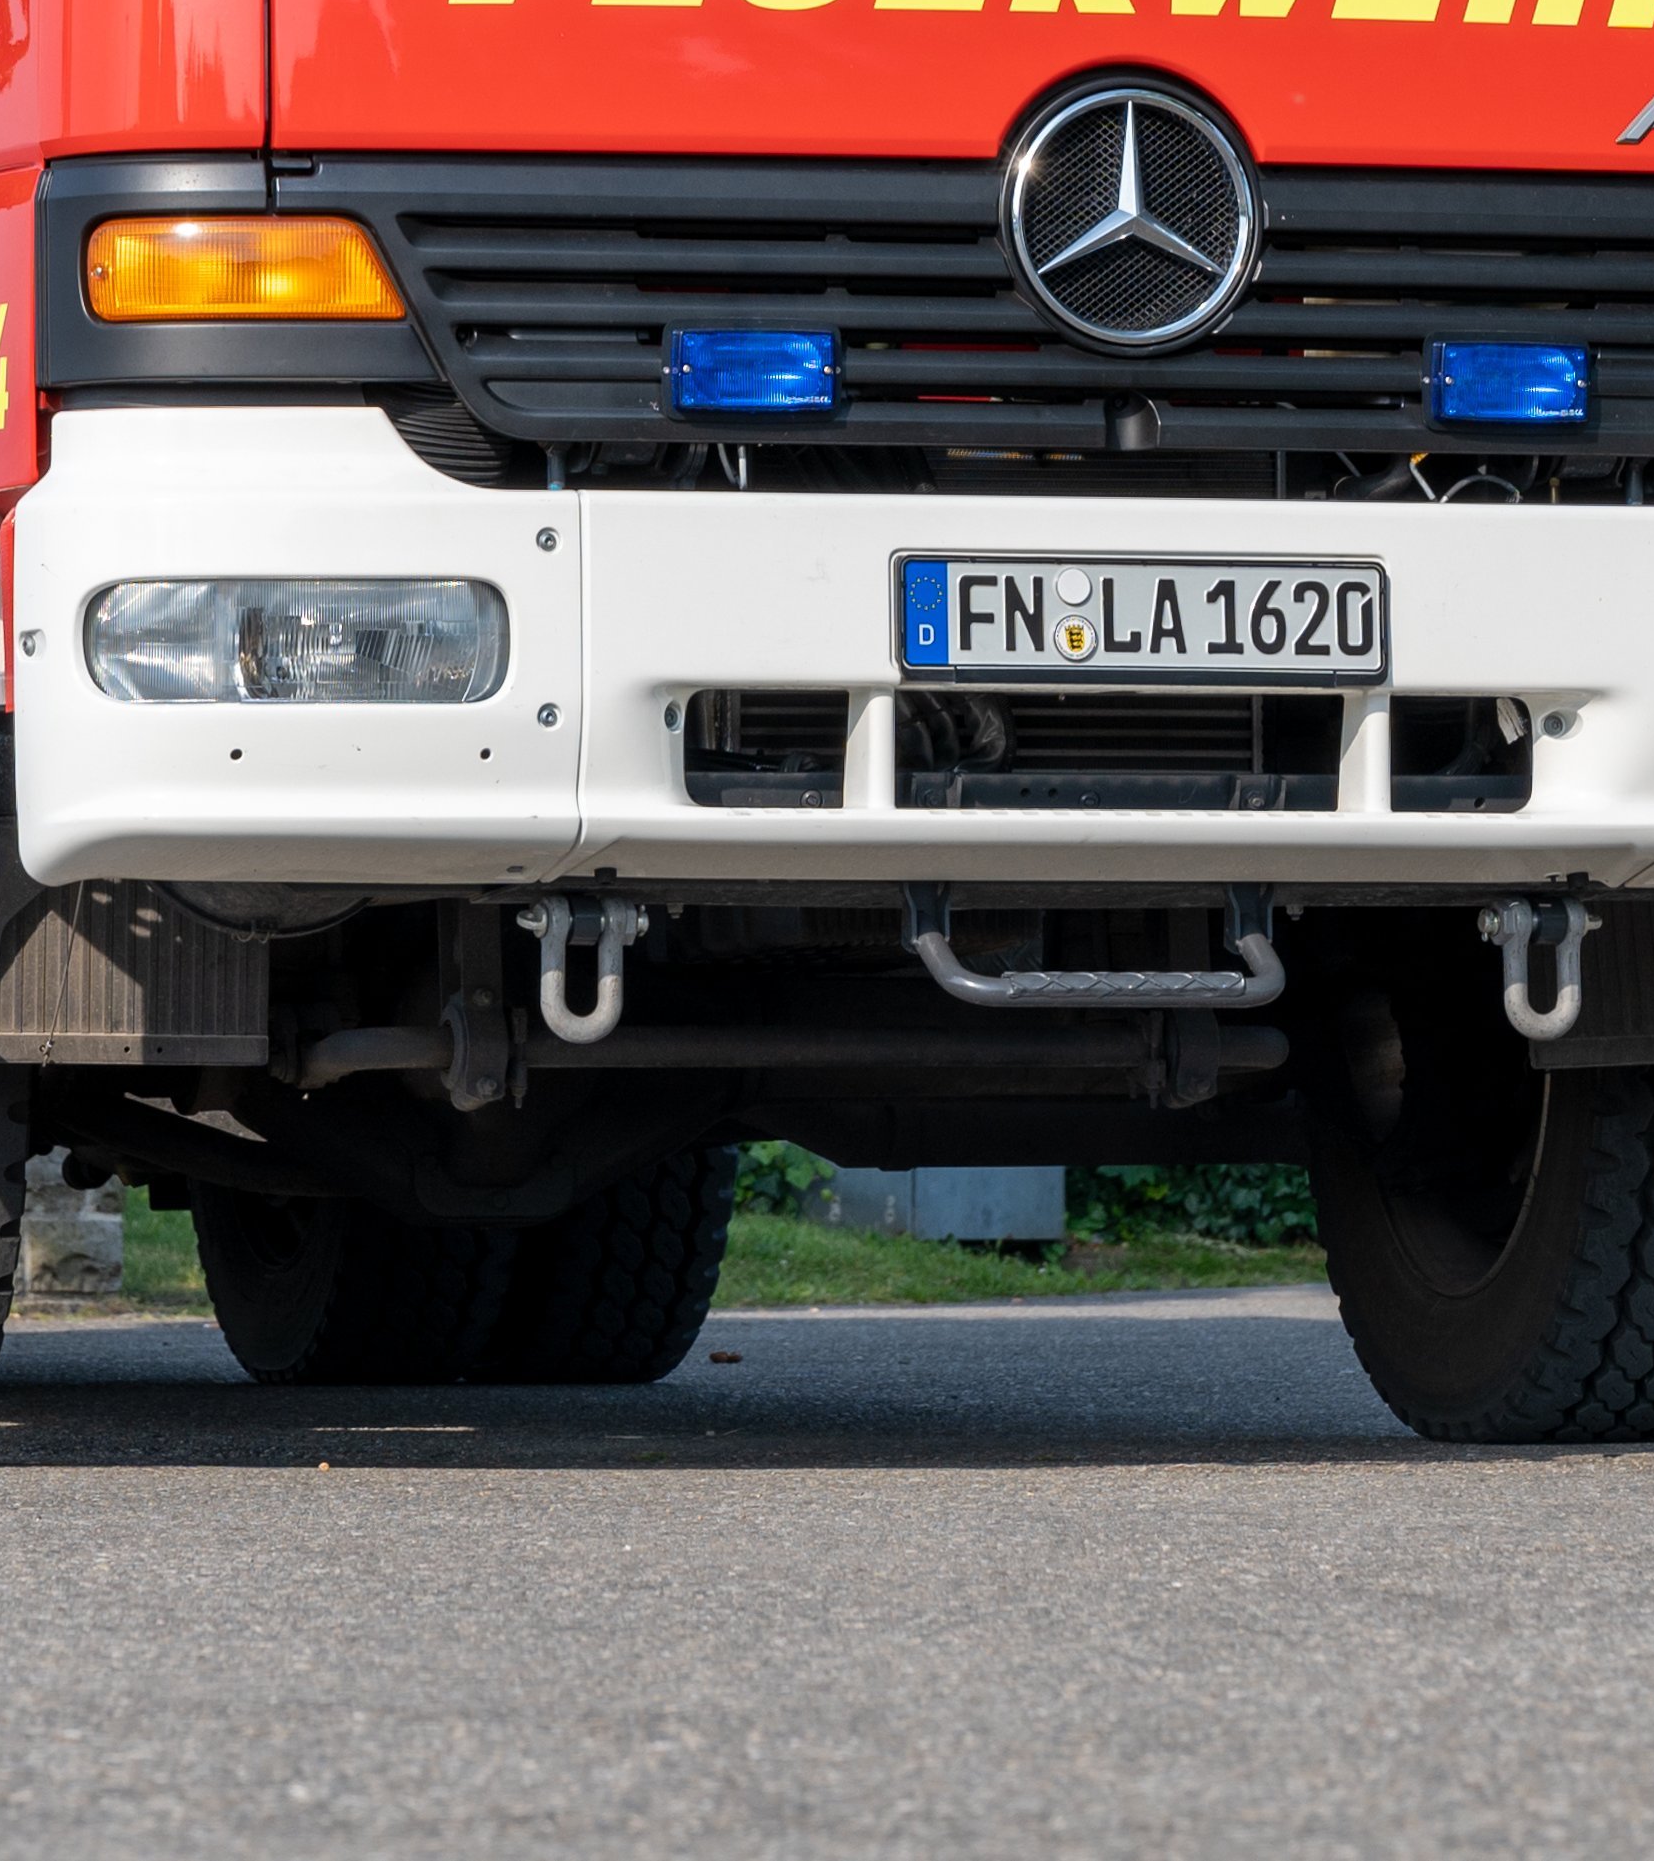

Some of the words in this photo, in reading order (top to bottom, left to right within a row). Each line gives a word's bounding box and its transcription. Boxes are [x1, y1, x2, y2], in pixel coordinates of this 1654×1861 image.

[918, 624, 935, 646] D
[958, 574, 1045, 652] FN
[1101, 576, 1187, 655] LA
[1205, 579, 1374, 656] 1620
